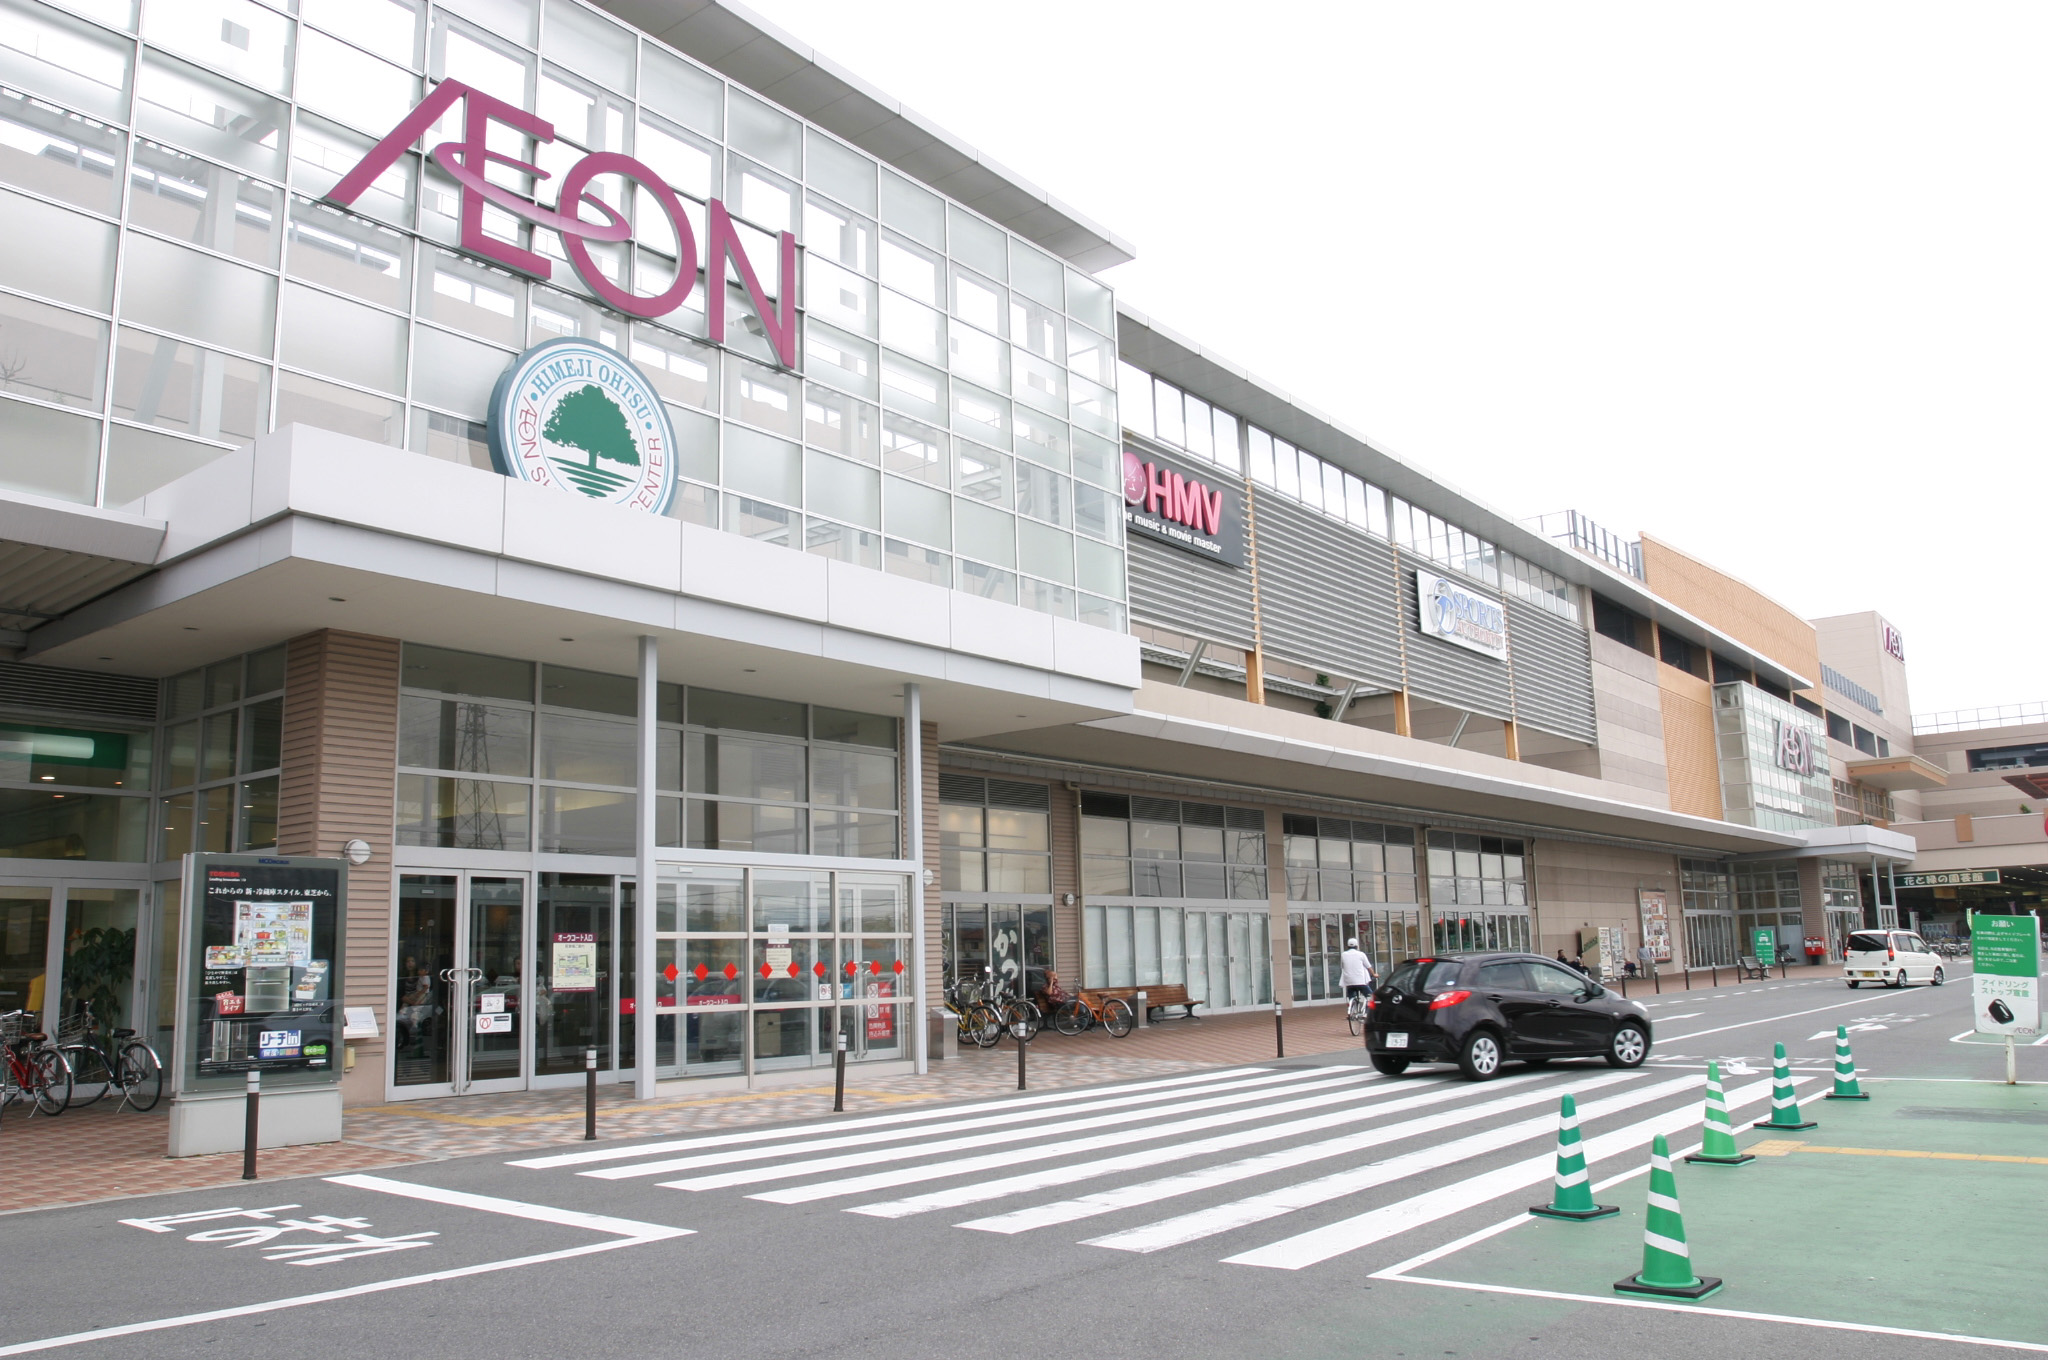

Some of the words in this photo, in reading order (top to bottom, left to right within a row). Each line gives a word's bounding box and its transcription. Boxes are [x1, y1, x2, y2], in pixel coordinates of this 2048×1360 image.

[531, 358, 593, 396] HIMEJI
[598, 365, 652, 421] OHTSU
[1144, 462, 1222, 536] HMV
[1134, 514, 1161, 532] music
[1161, 525, 1168, 535] &
[1168, 527, 1193, 543] movie
[1193, 536, 1222, 554] master
[1454, 591, 1504, 635] SPORTS
[1904, 873, 1984, 886] 花と緑の園芸館
[208, 887, 244, 895] これからの
[1991, 919, 2015, 928] お願い
[557, 934, 594, 942] オークコート入口
[1981, 979, 2029, 989] アイドリング
[223, 1004, 240, 1012] タイプ
